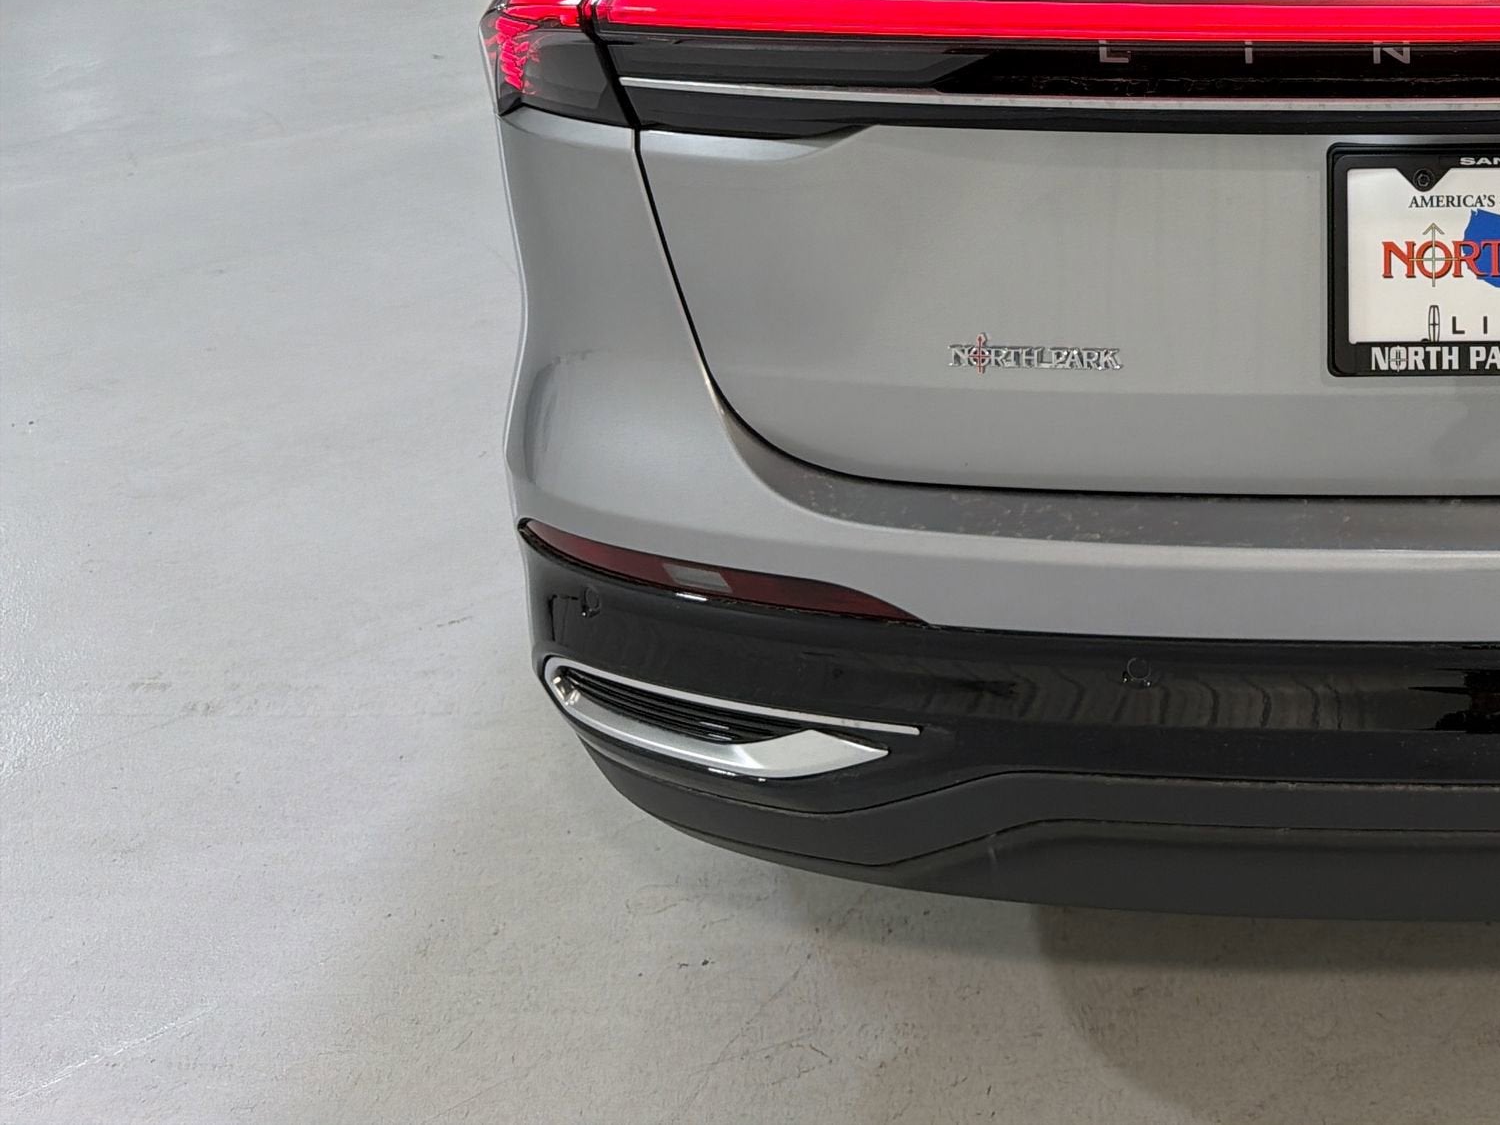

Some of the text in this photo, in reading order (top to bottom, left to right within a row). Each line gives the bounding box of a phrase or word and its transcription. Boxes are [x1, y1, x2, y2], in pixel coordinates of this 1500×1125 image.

[1408, 195, 1496, 208] AMERICA'S
[948, 344, 1125, 371] NORTH PARK
[1371, 345, 1460, 372] NORTH
